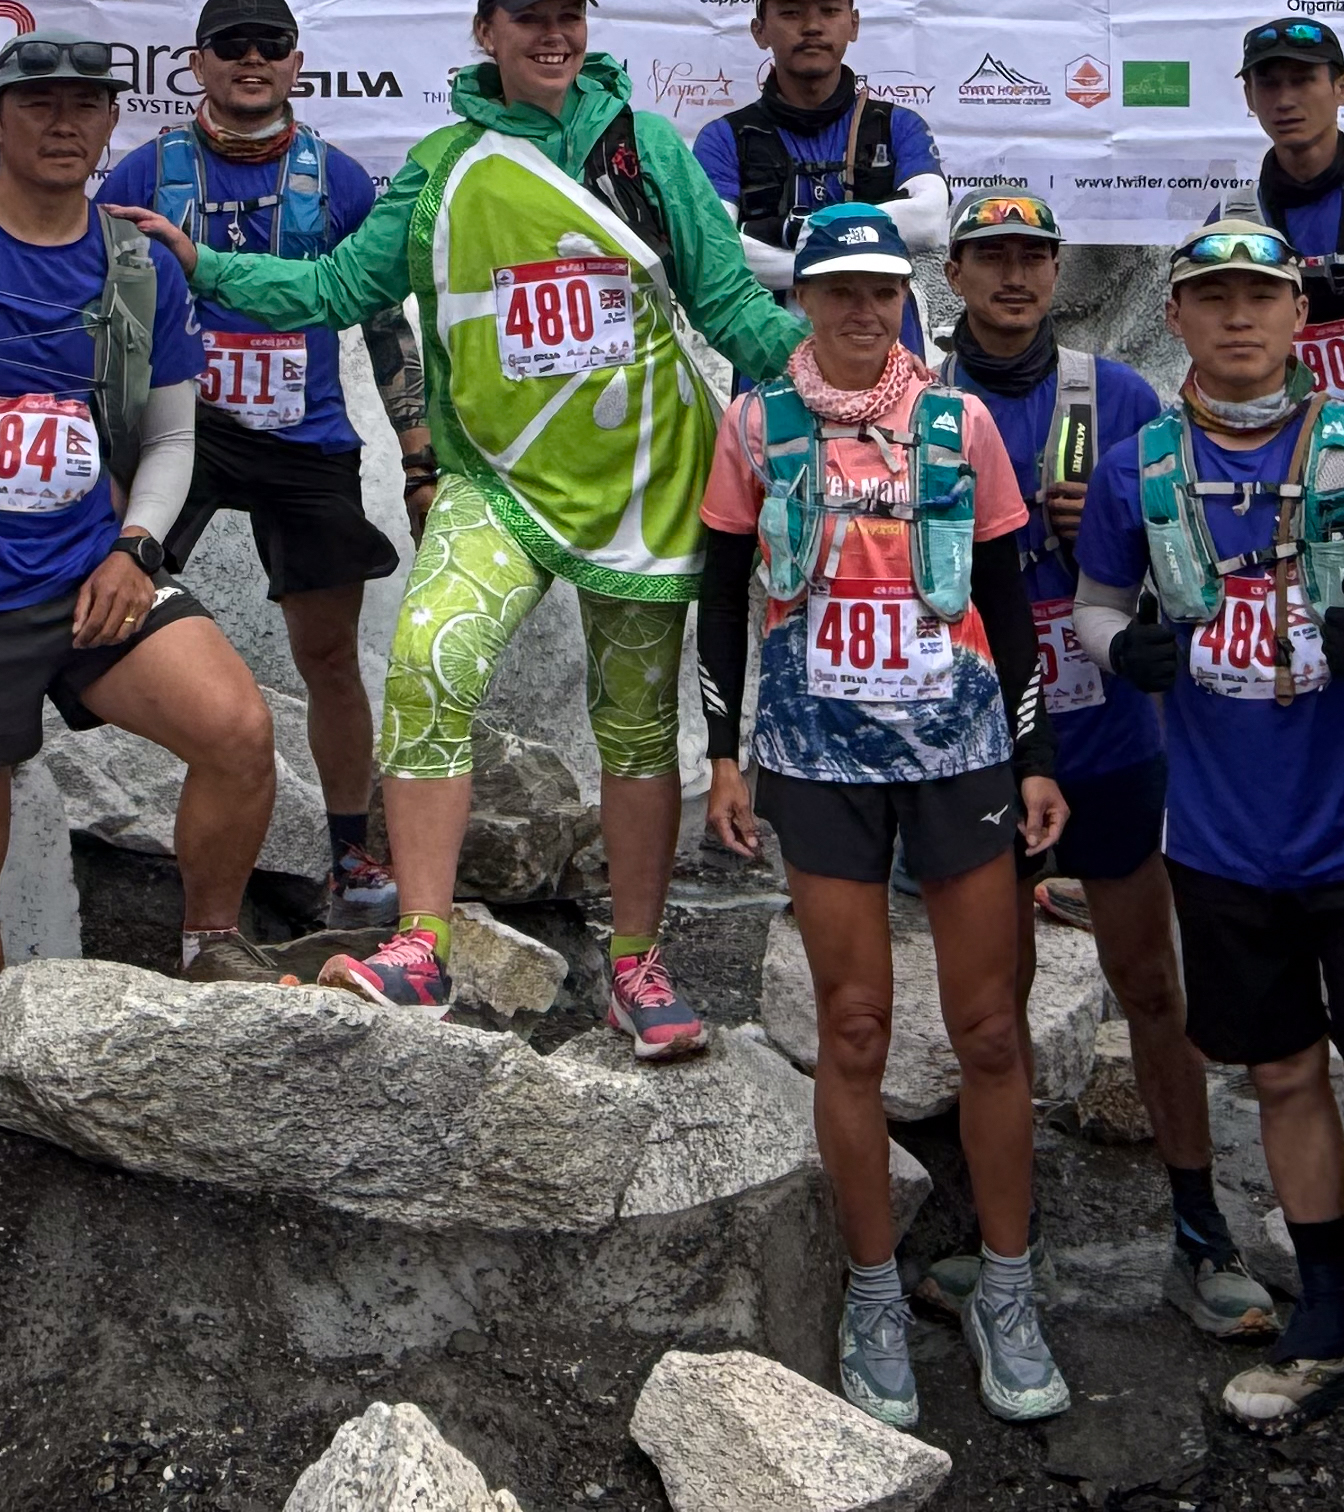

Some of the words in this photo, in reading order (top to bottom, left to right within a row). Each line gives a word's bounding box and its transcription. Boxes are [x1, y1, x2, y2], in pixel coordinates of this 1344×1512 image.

[288, 71, 404, 98] SILVA
[505, 278, 595, 350] 480
[200, 351, 276, 405] 511
[815, 601, 910, 670] 481
